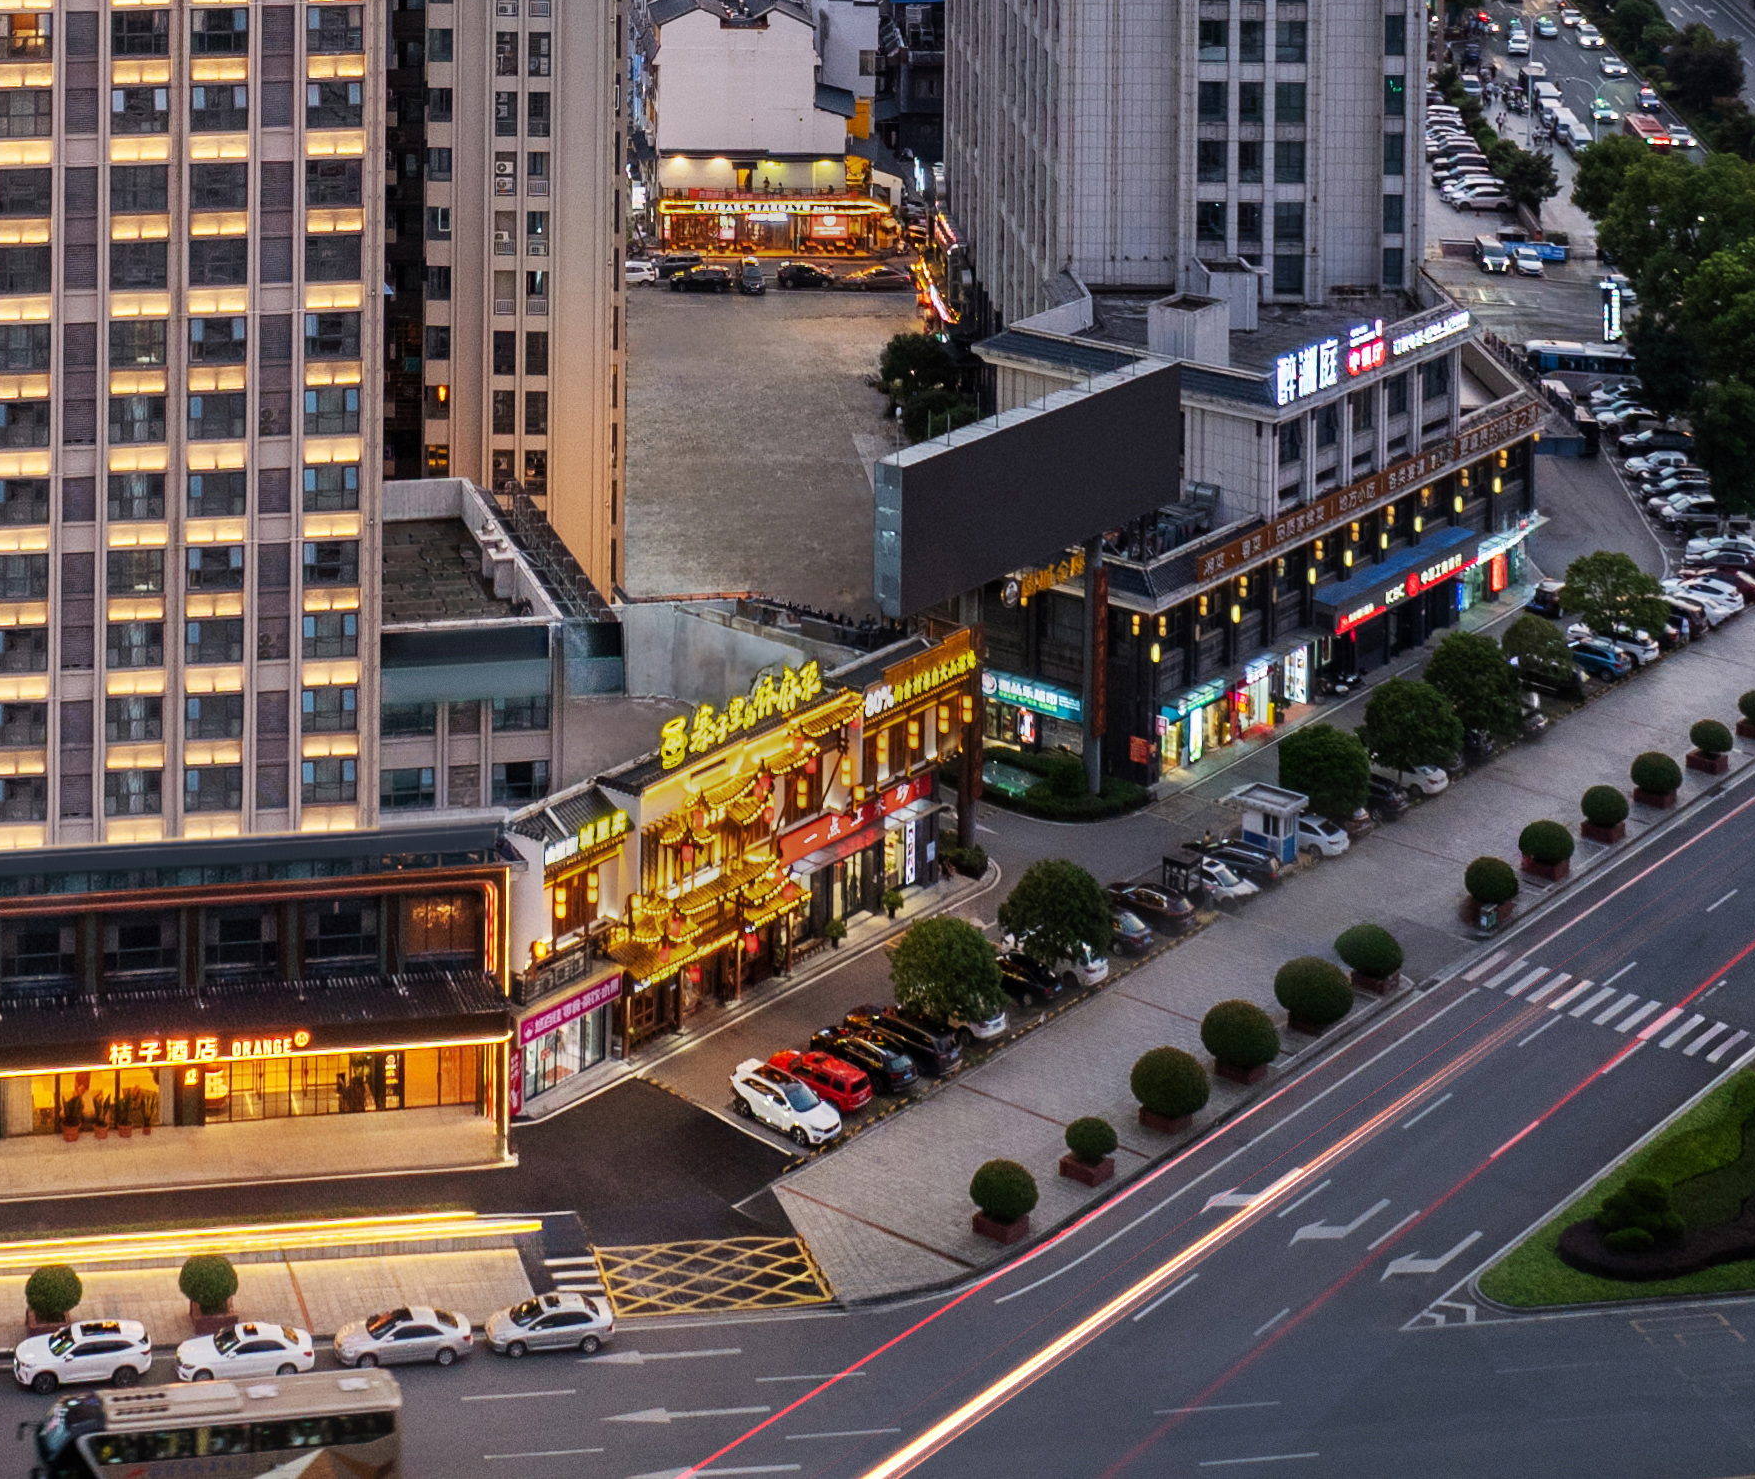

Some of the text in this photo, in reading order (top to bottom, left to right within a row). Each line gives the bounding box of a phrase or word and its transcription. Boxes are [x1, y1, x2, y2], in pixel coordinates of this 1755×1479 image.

[108, 1037, 293, 1066] 桔子酒店 ORANGE
